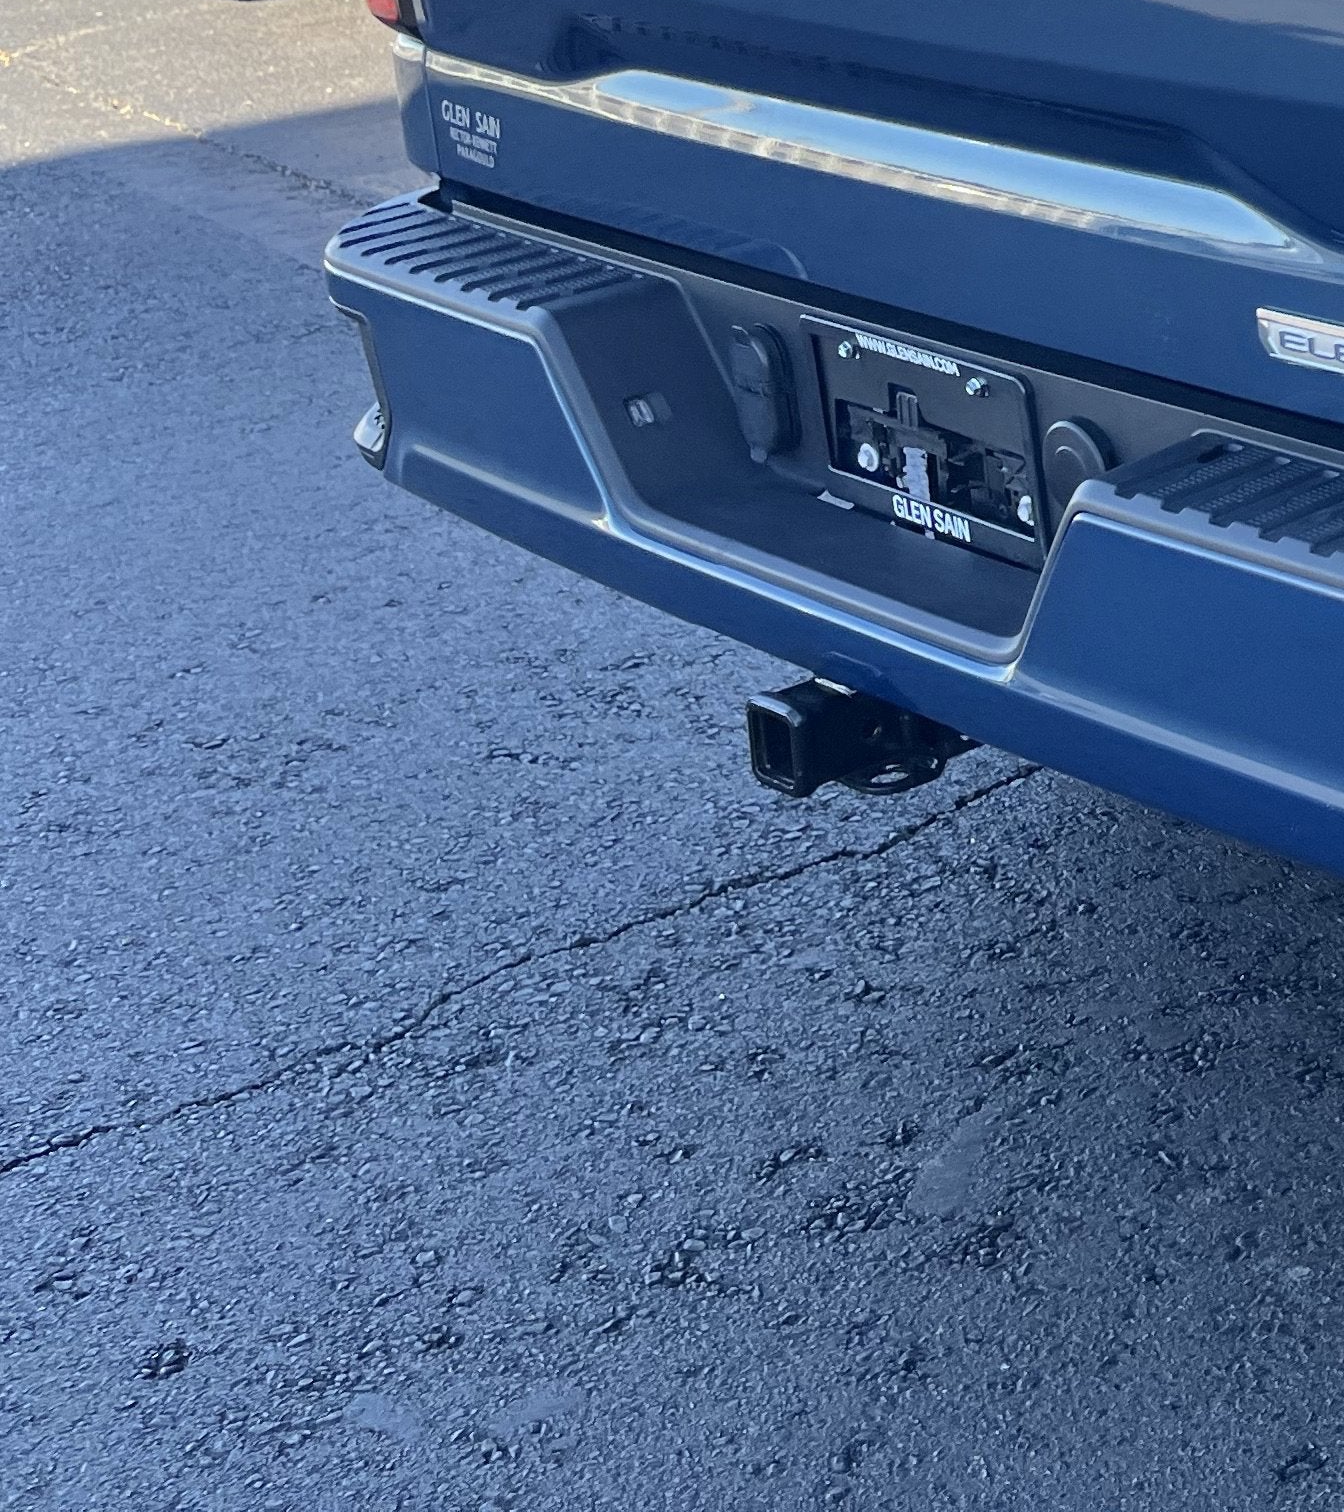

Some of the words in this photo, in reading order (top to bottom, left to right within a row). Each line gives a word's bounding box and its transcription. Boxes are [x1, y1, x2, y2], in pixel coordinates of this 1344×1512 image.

[441, 99, 470, 128] GLEN
[475, 111, 500, 139] SAIN
[854, 331, 961, 377] WWW.GLENSAIN.COM
[892, 494, 932, 529] GLEN
[933, 508, 972, 543] SAIN
